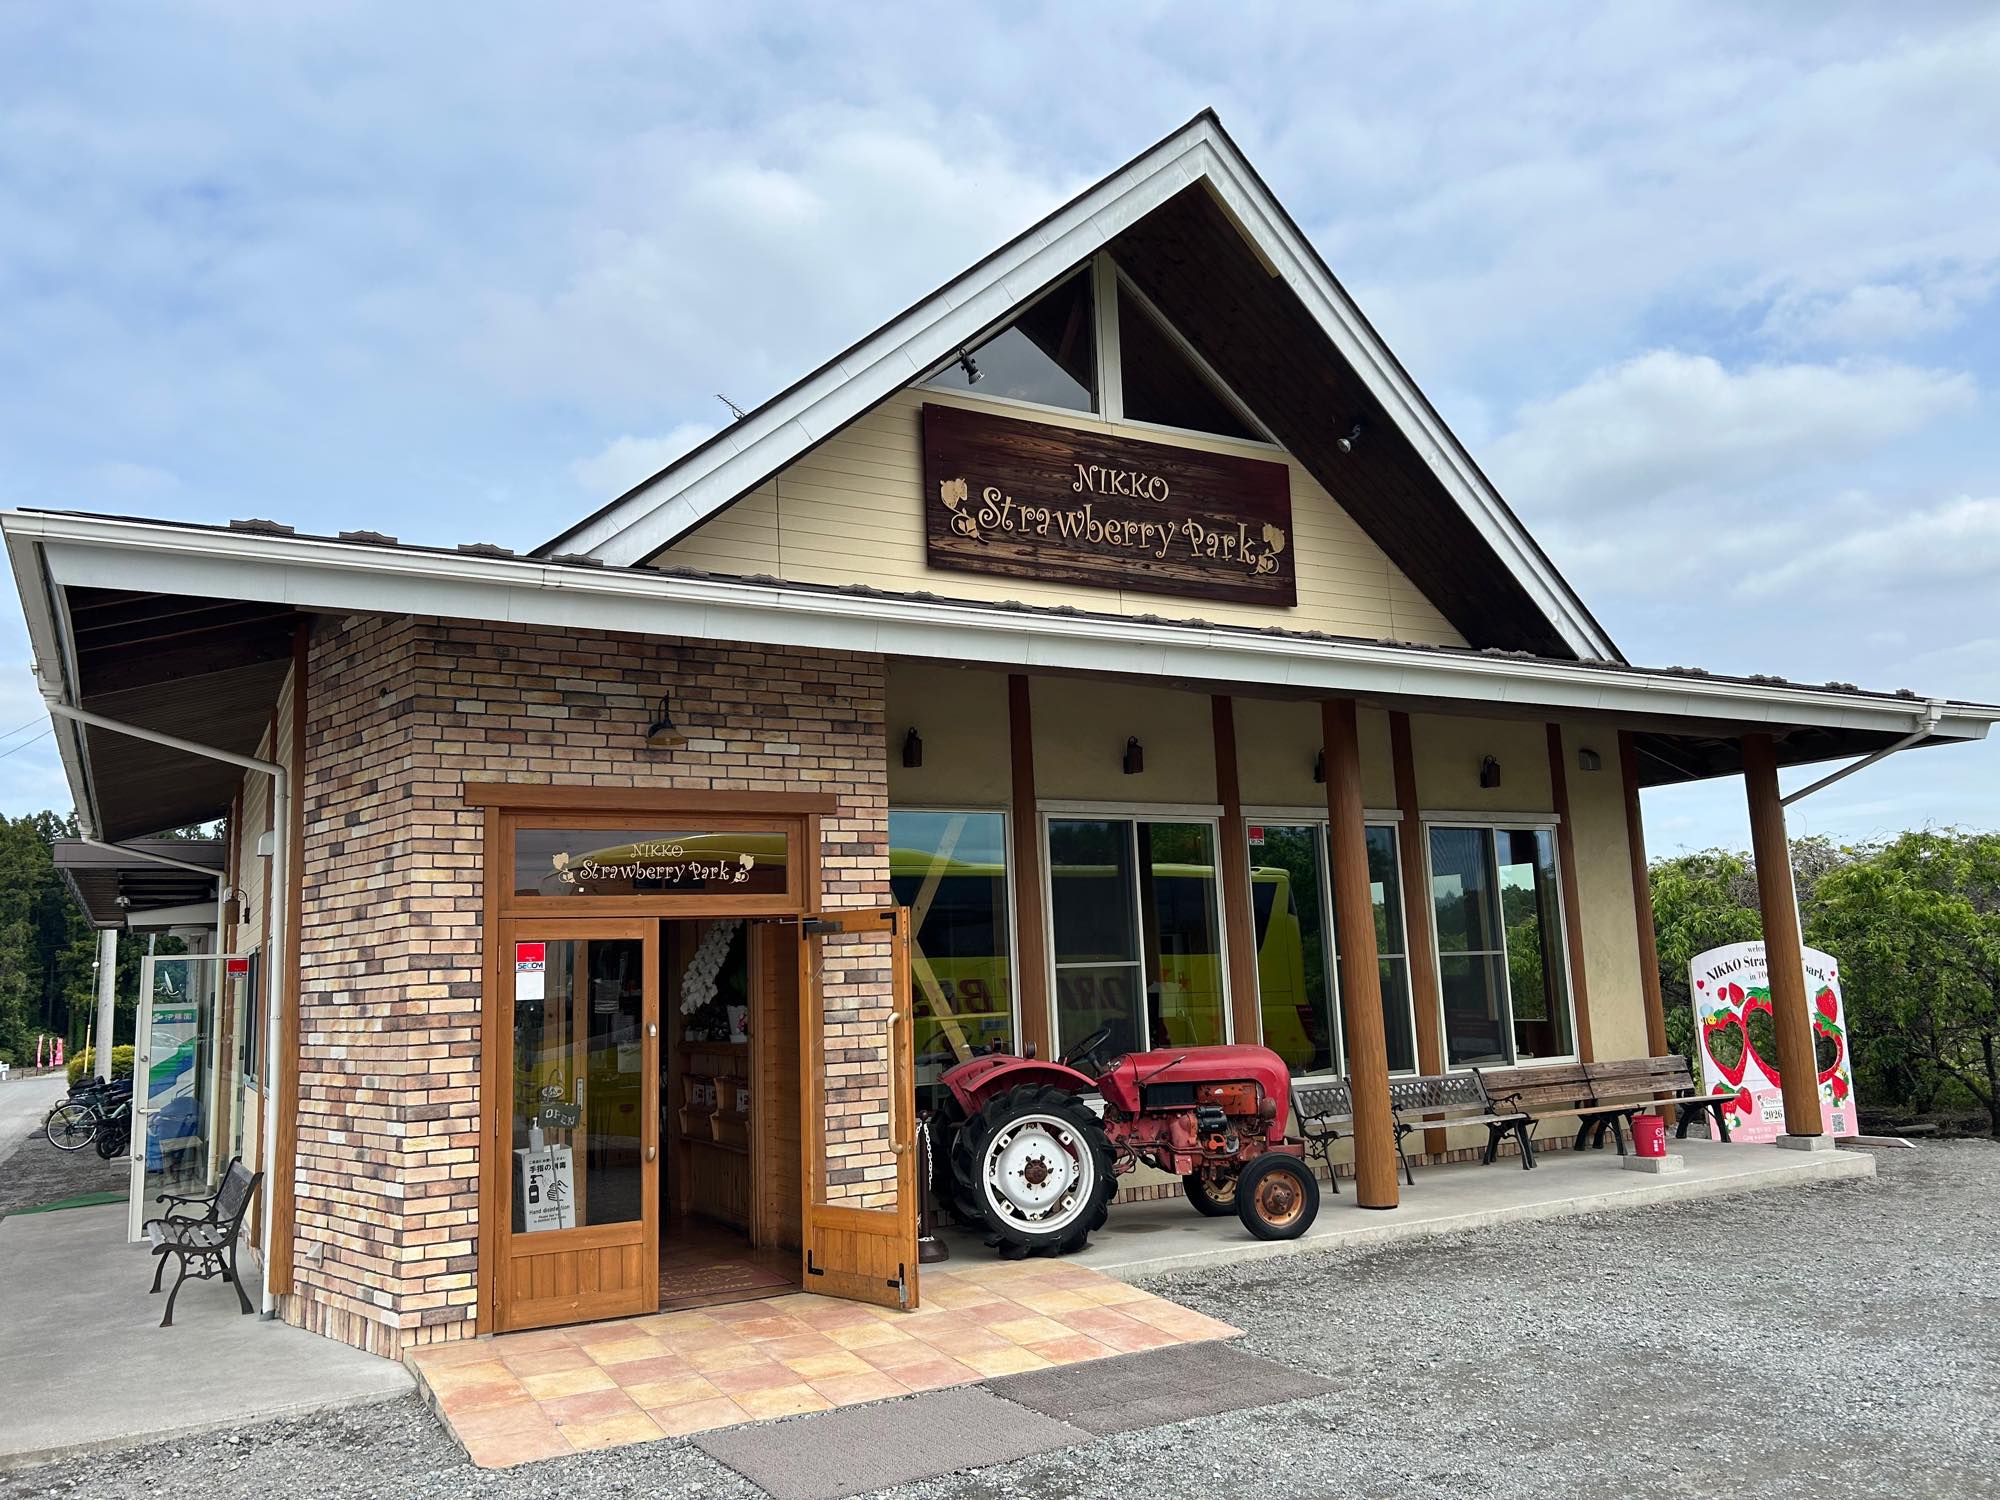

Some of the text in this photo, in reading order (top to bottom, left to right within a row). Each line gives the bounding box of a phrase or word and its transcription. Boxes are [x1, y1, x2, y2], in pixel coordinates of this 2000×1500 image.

[1072, 463, 1169, 502] NIKKO
[978, 486, 1257, 565] Strawberry Park
[630, 844, 684, 858] NIKKO
[580, 859, 730, 883] Strawberry Park
[1747, 944, 1765, 953] welco
[1706, 958, 1742, 981] NIKKO
[1743, 956, 1767, 969] Stra
[545, 1108, 575, 1125] OPEN
[1763, 1109, 1783, 1120] 2026
